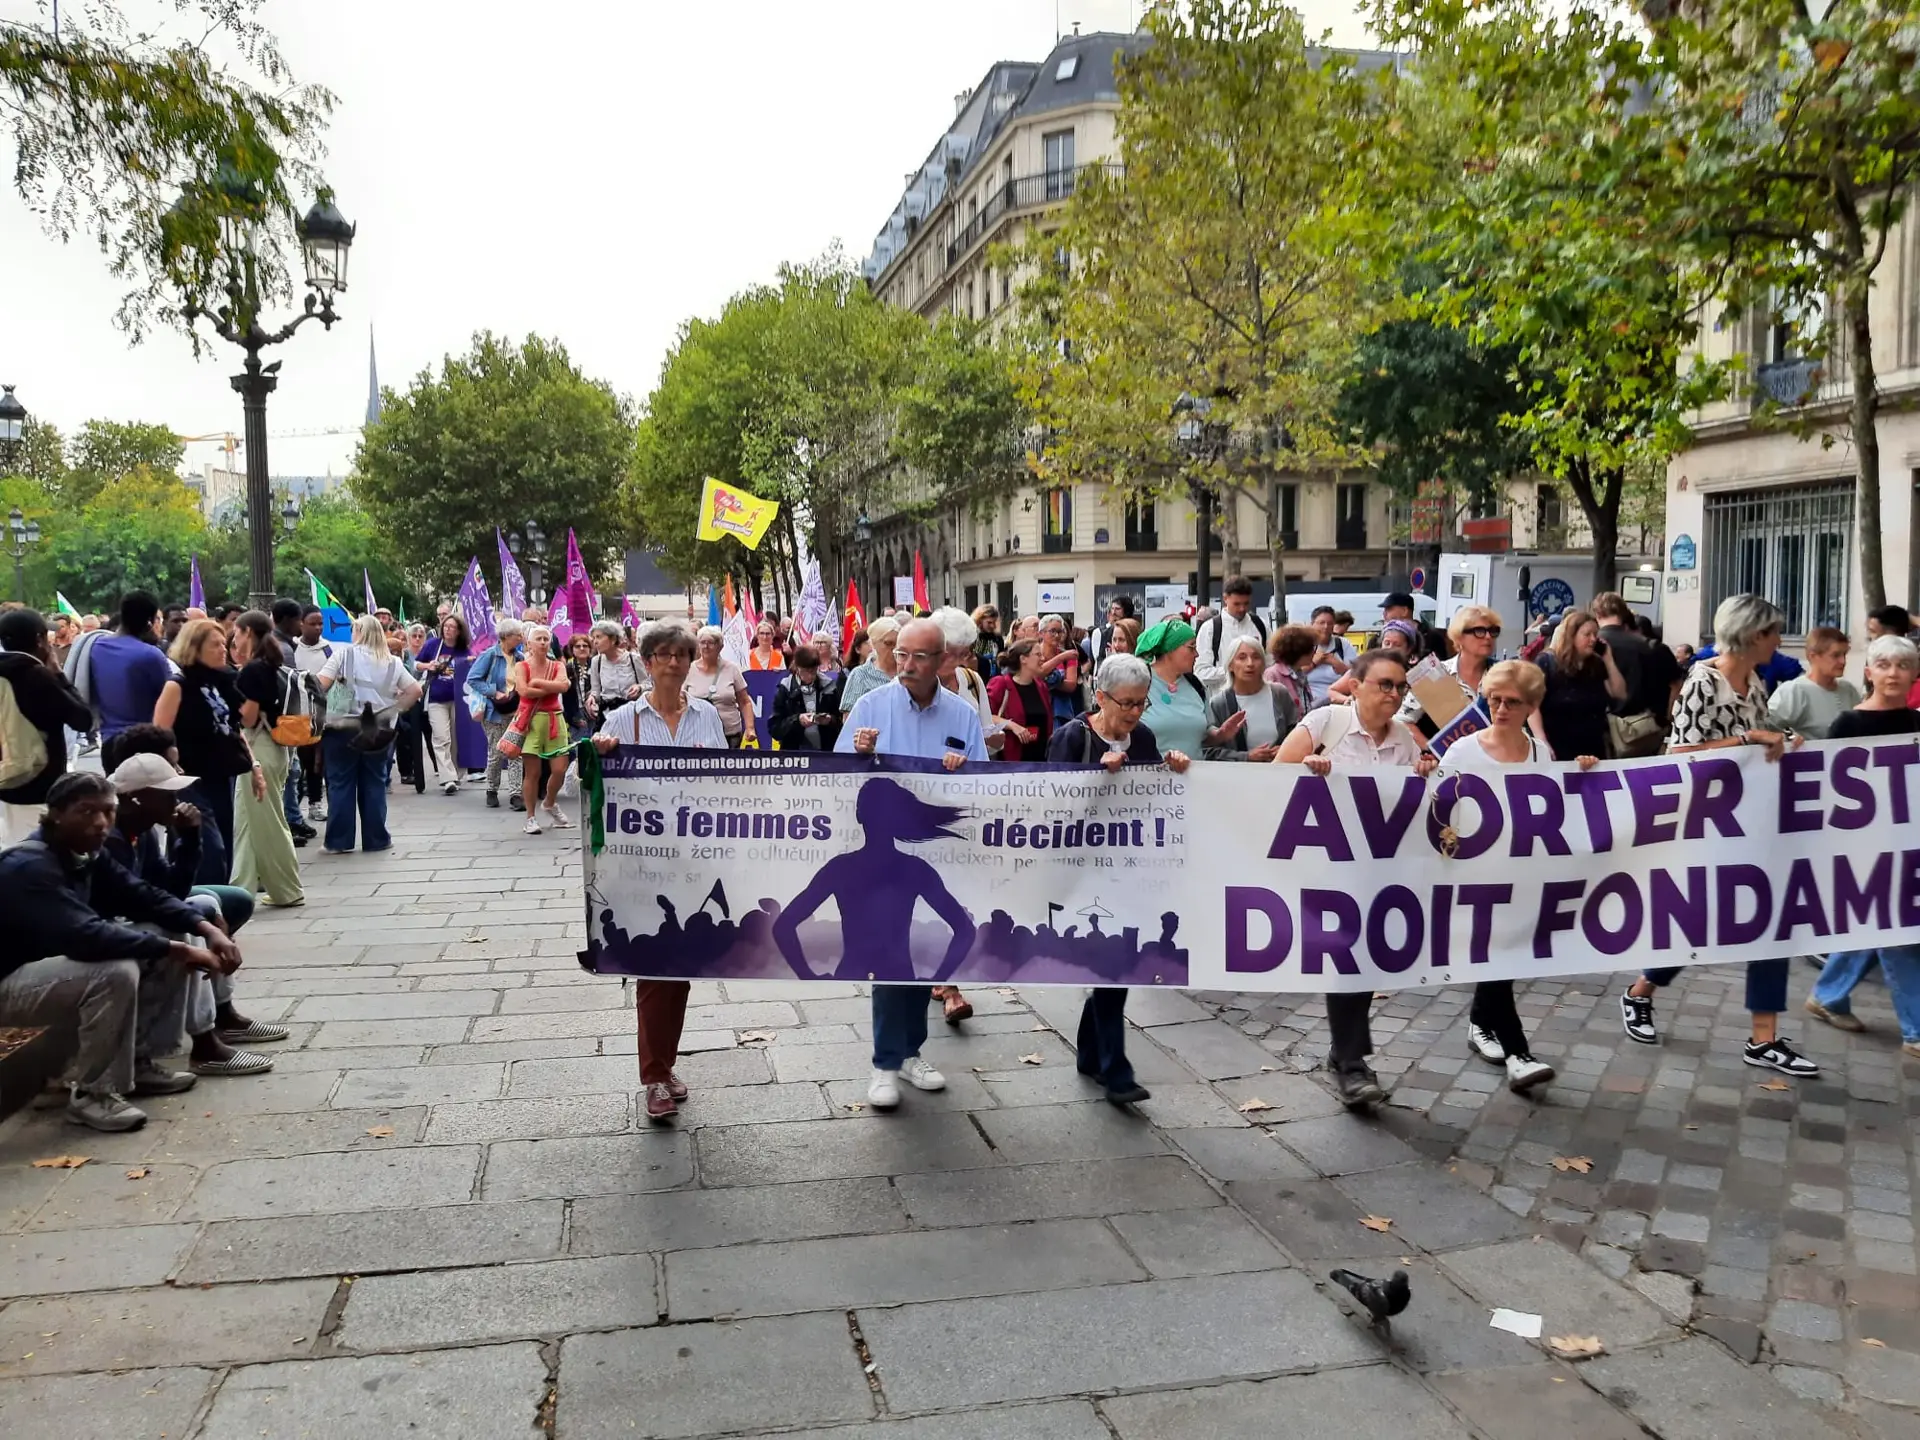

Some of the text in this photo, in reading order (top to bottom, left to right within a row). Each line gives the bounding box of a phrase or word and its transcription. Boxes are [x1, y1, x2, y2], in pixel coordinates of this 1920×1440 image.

[1051, 781, 1117, 799] Women
[1123, 778, 1185, 796] decide
[1266, 743, 1920, 862] AVORTER EST
[606, 802, 665, 836] les
[676, 805, 832, 841] femmes
[983, 818, 1143, 850] décident
[1224, 883, 1514, 975] DROIT
